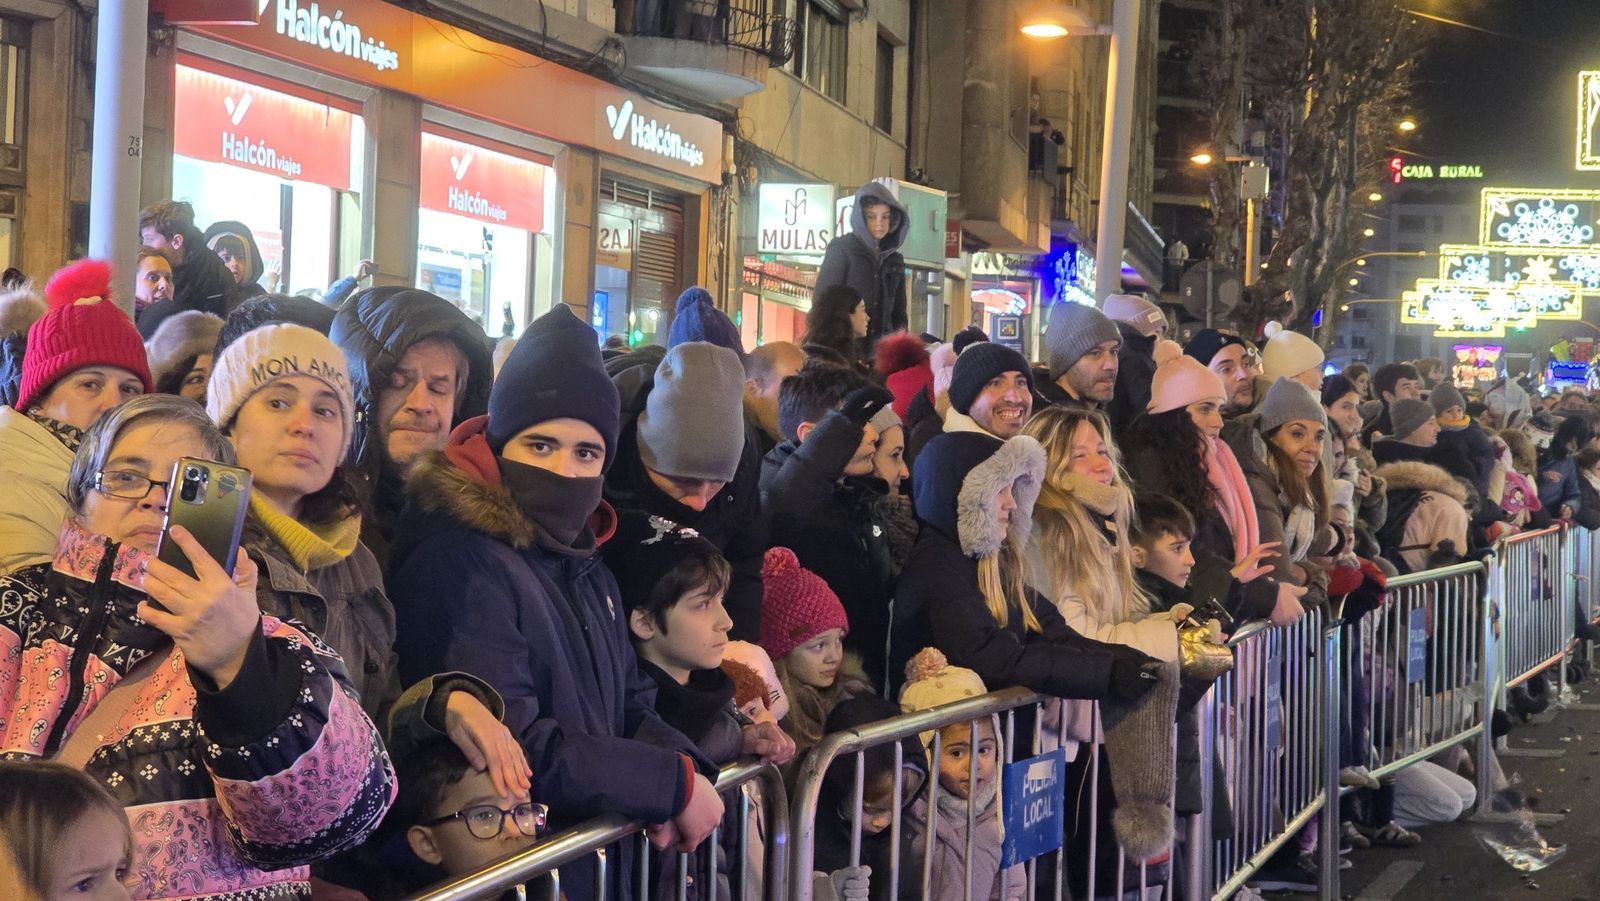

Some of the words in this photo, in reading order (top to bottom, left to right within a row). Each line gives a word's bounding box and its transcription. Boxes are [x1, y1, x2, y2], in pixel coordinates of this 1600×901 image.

[276, 0, 361, 58] Halcón
[360, 37, 398, 70] viajes
[631, 112, 681, 159] Halcón
[222, 131, 276, 169] Halcón
[276, 155, 302, 176] viajes
[1401, 165, 1433, 179] CAJA
[1440, 165, 1483, 178] RURAL
[448, 185, 489, 216] Halcón
[762, 229, 829, 250] MULAS
[251, 355, 299, 386] MON
[1023, 795, 1054, 828] LOCAL
